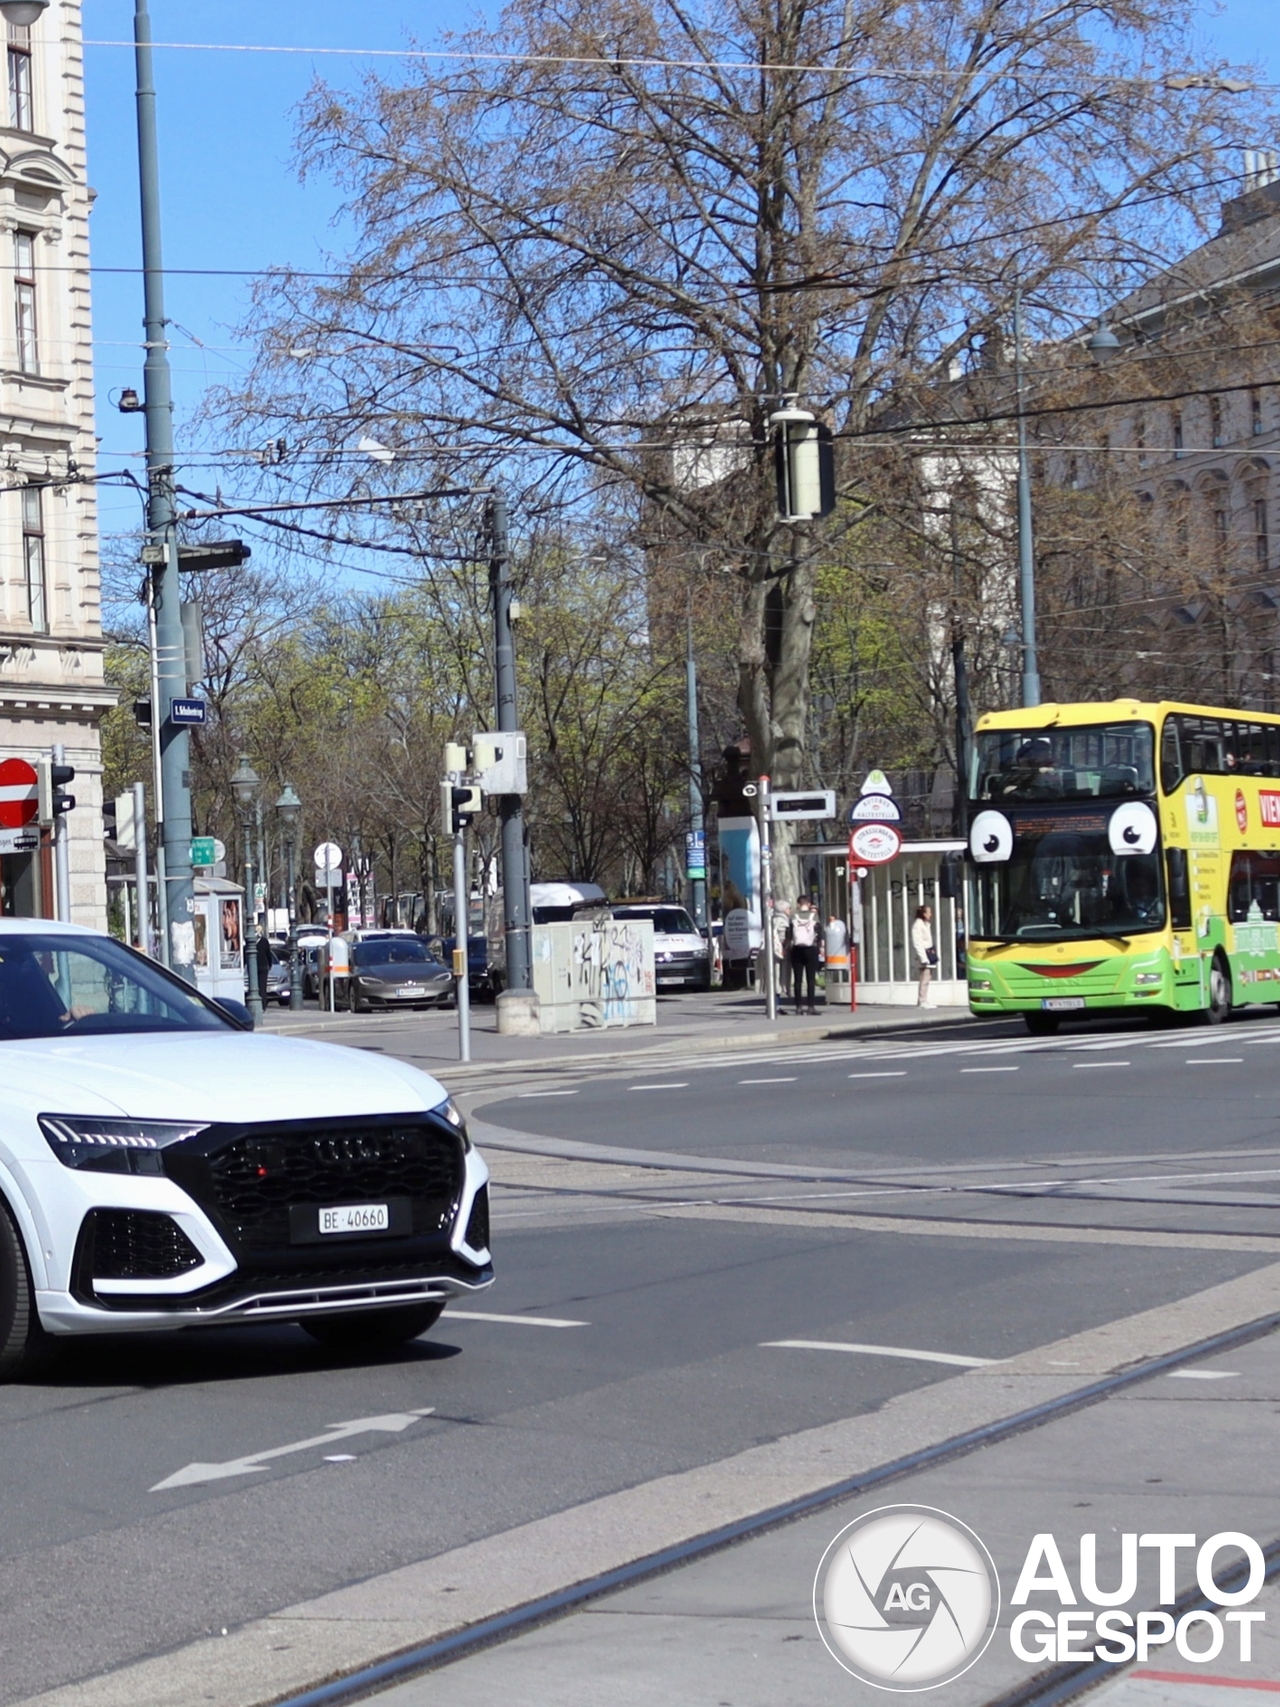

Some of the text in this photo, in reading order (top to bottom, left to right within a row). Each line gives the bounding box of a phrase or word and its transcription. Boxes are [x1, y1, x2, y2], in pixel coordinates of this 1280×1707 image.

[863, 797, 891, 808] AUTOBUS
[858, 847, 893, 859] HALTESTELLE
[324, 1209, 384, 1229] BE 40660
